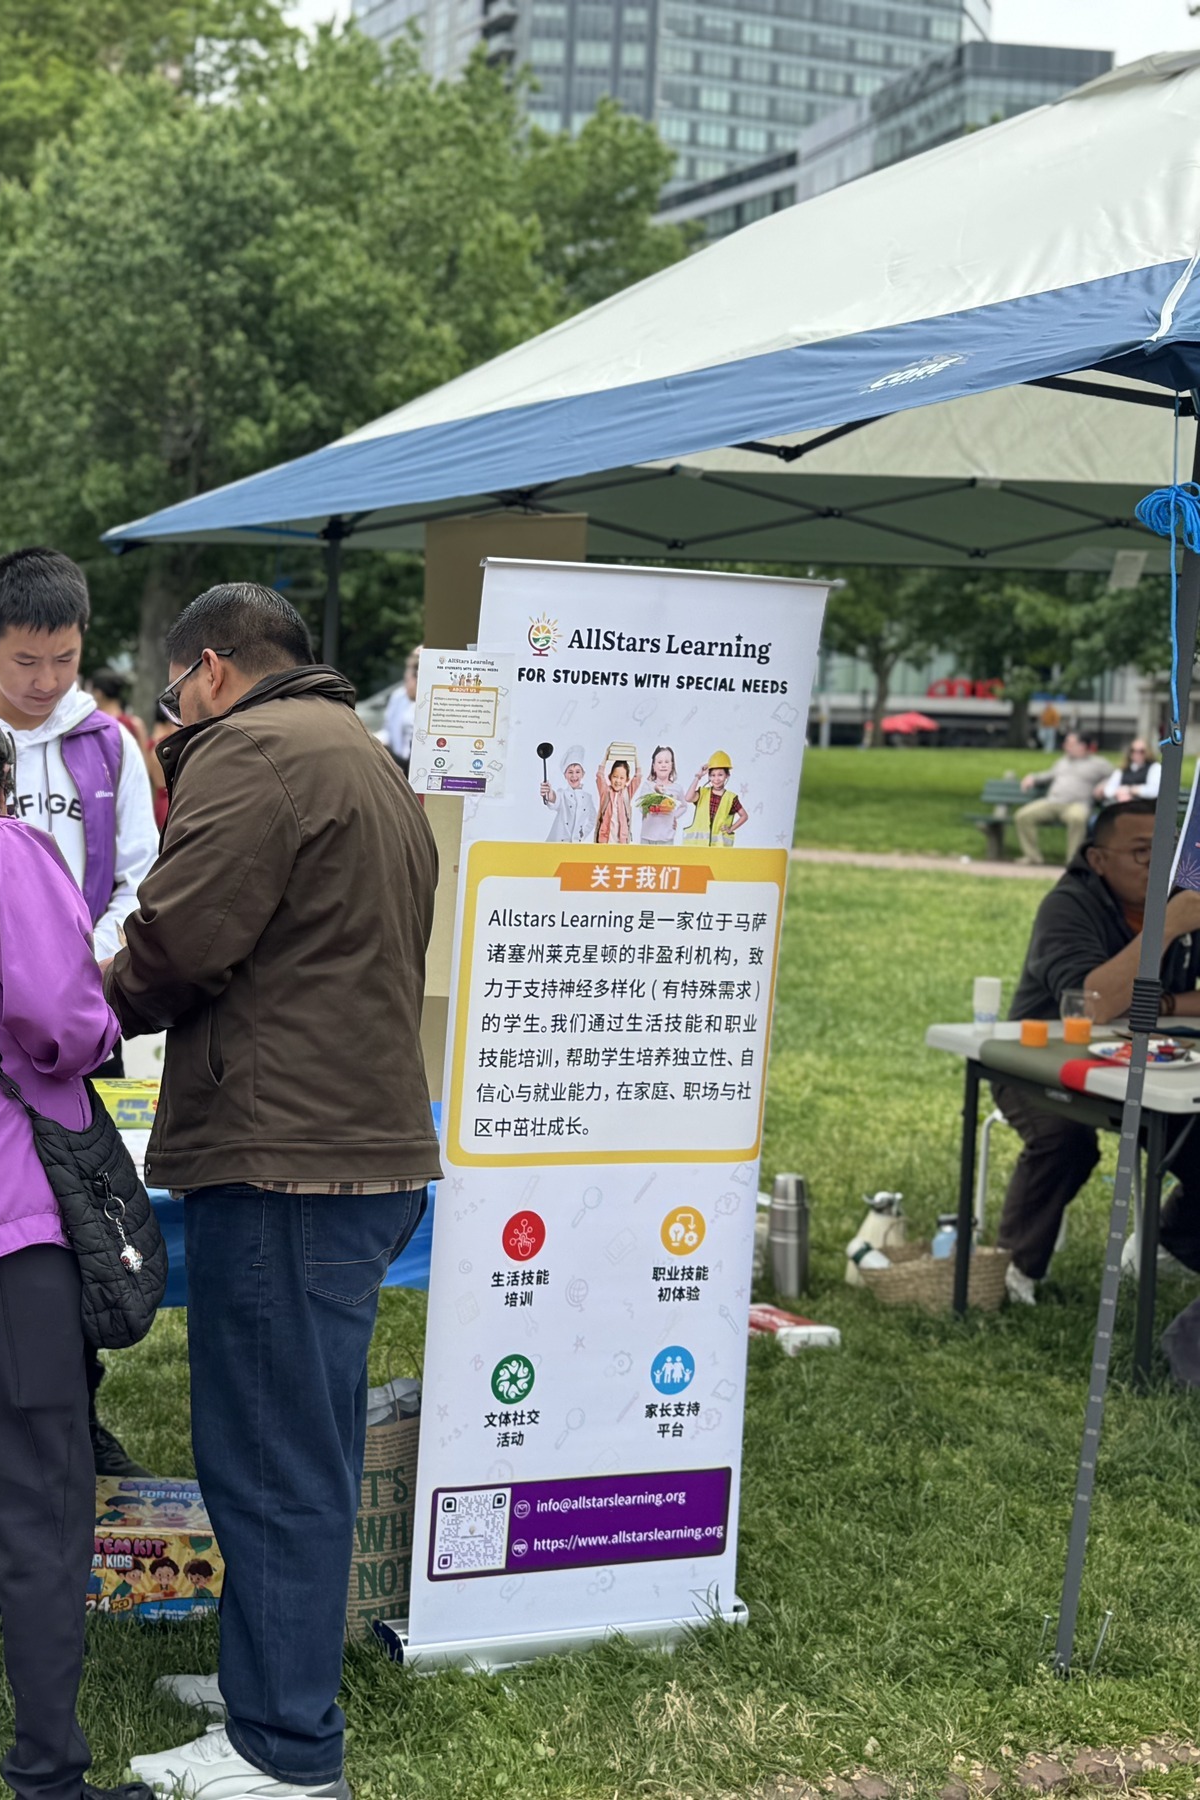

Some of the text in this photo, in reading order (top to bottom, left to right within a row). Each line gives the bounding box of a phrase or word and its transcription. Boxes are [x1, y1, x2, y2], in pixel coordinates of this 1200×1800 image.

[567, 628, 772, 665] AllStars Learning
[517, 667, 788, 696] FOR STUDENTS WITH SPECIAL NEEDS
[590, 865, 681, 891] 关于我们
[488, 909, 768, 932] Allstars Learning 是一家位于马萨
[481, 1012, 758, 1034] 的学生。我们通过生活技能和职业
[478, 1047, 755, 1069] 技能培训，帮助学生培养独立性、自
[476, 1080, 752, 1103] 信心与就业能力，在家庭、职场与社
[474, 1117, 590, 1138] 区中茁壮成长。
[490, 1269, 550, 1289] 生活技能
[652, 1265, 710, 1283] 职业技能
[504, 1291, 534, 1308] 培训
[657, 1287, 701, 1303] 初体验
[483, 1410, 541, 1429] 文体社交
[644, 1401, 700, 1419] 家长支持
[496, 1431, 525, 1448] 活动
[656, 1423, 685, 1438] 平台
[140, 1490, 202, 1500] FOR KIDS
[536, 1489, 686, 1514] info@allstarslearning.org
[133, 1538, 167, 1558] KIT
[533, 1524, 724, 1554] https://www.allstarslearning.org
[106, 1554, 133, 1569] KIDS
[112, 1599, 129, 1610] PCS
